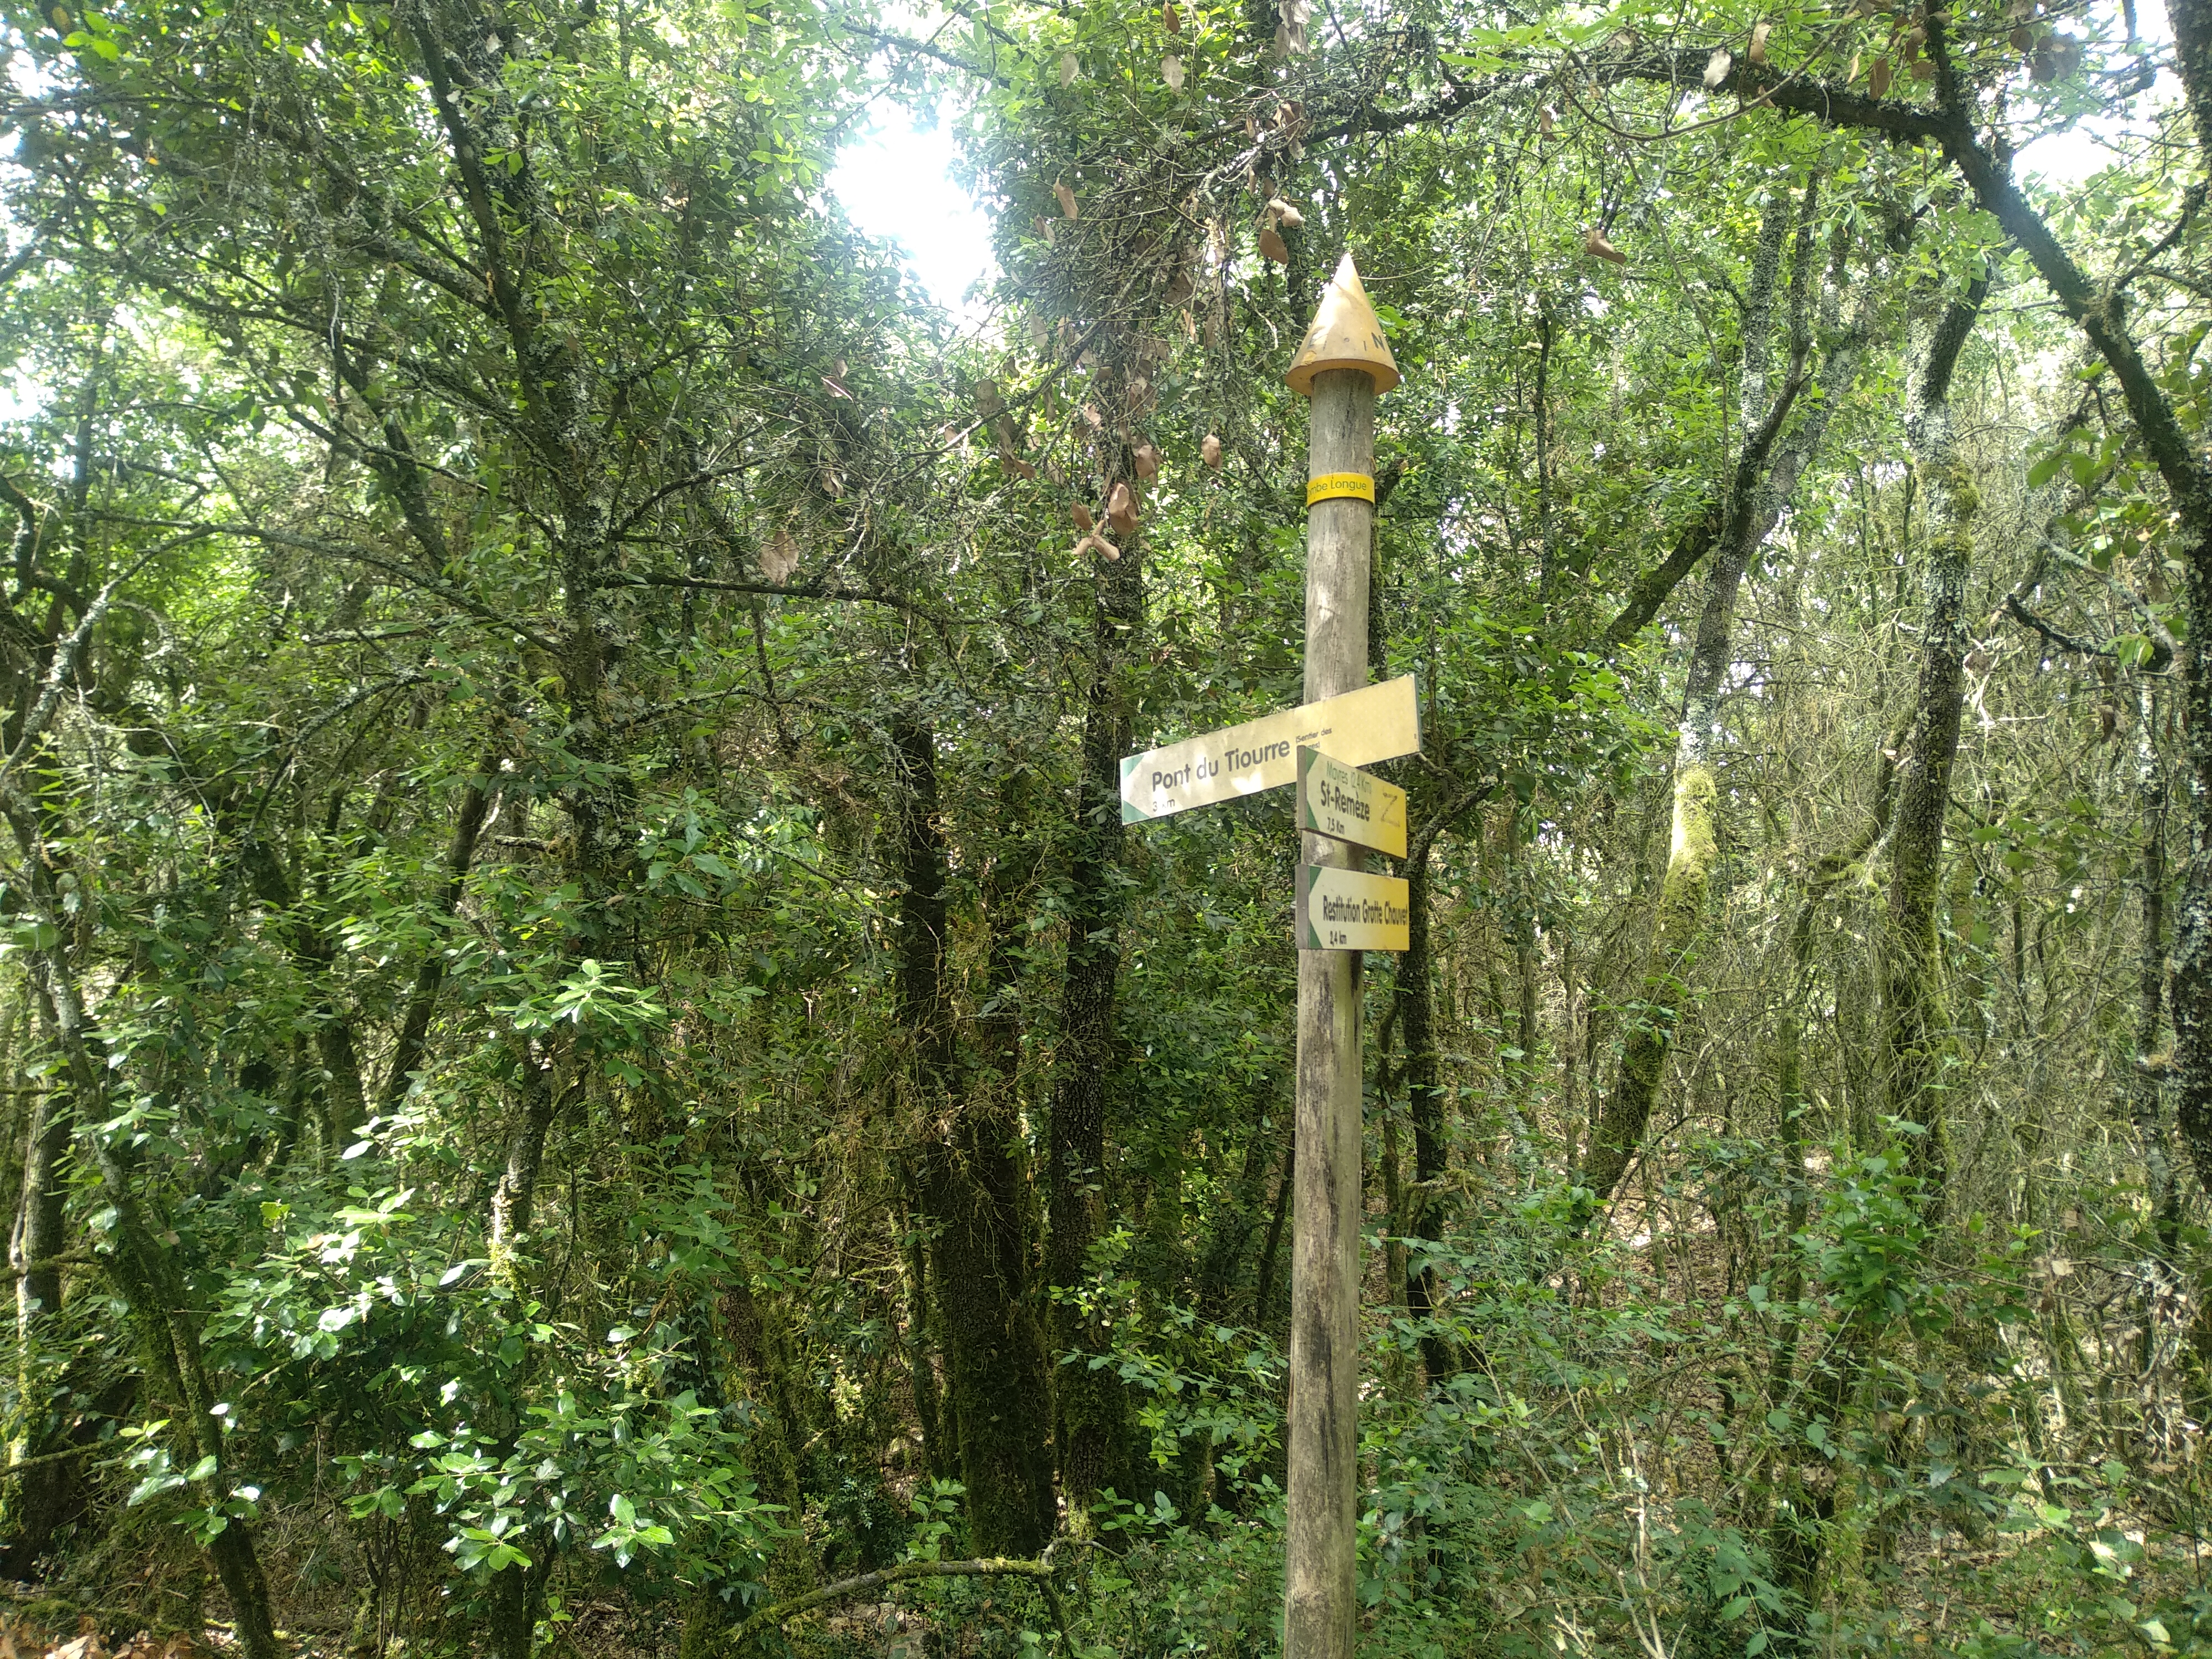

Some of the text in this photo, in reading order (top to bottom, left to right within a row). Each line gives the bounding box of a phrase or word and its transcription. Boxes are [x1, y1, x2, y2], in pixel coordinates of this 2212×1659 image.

[1371, 332, 1385, 351] N
[1308, 479, 1366, 497] ombe Longue
[1152, 740, 1290, 792] Pont du Tiourre
[1152, 801, 1158, 812] 3
[1321, 780, 1370, 822] St-Remèze
[1323, 895, 1408, 926] Restitution Grotte Chauvet
